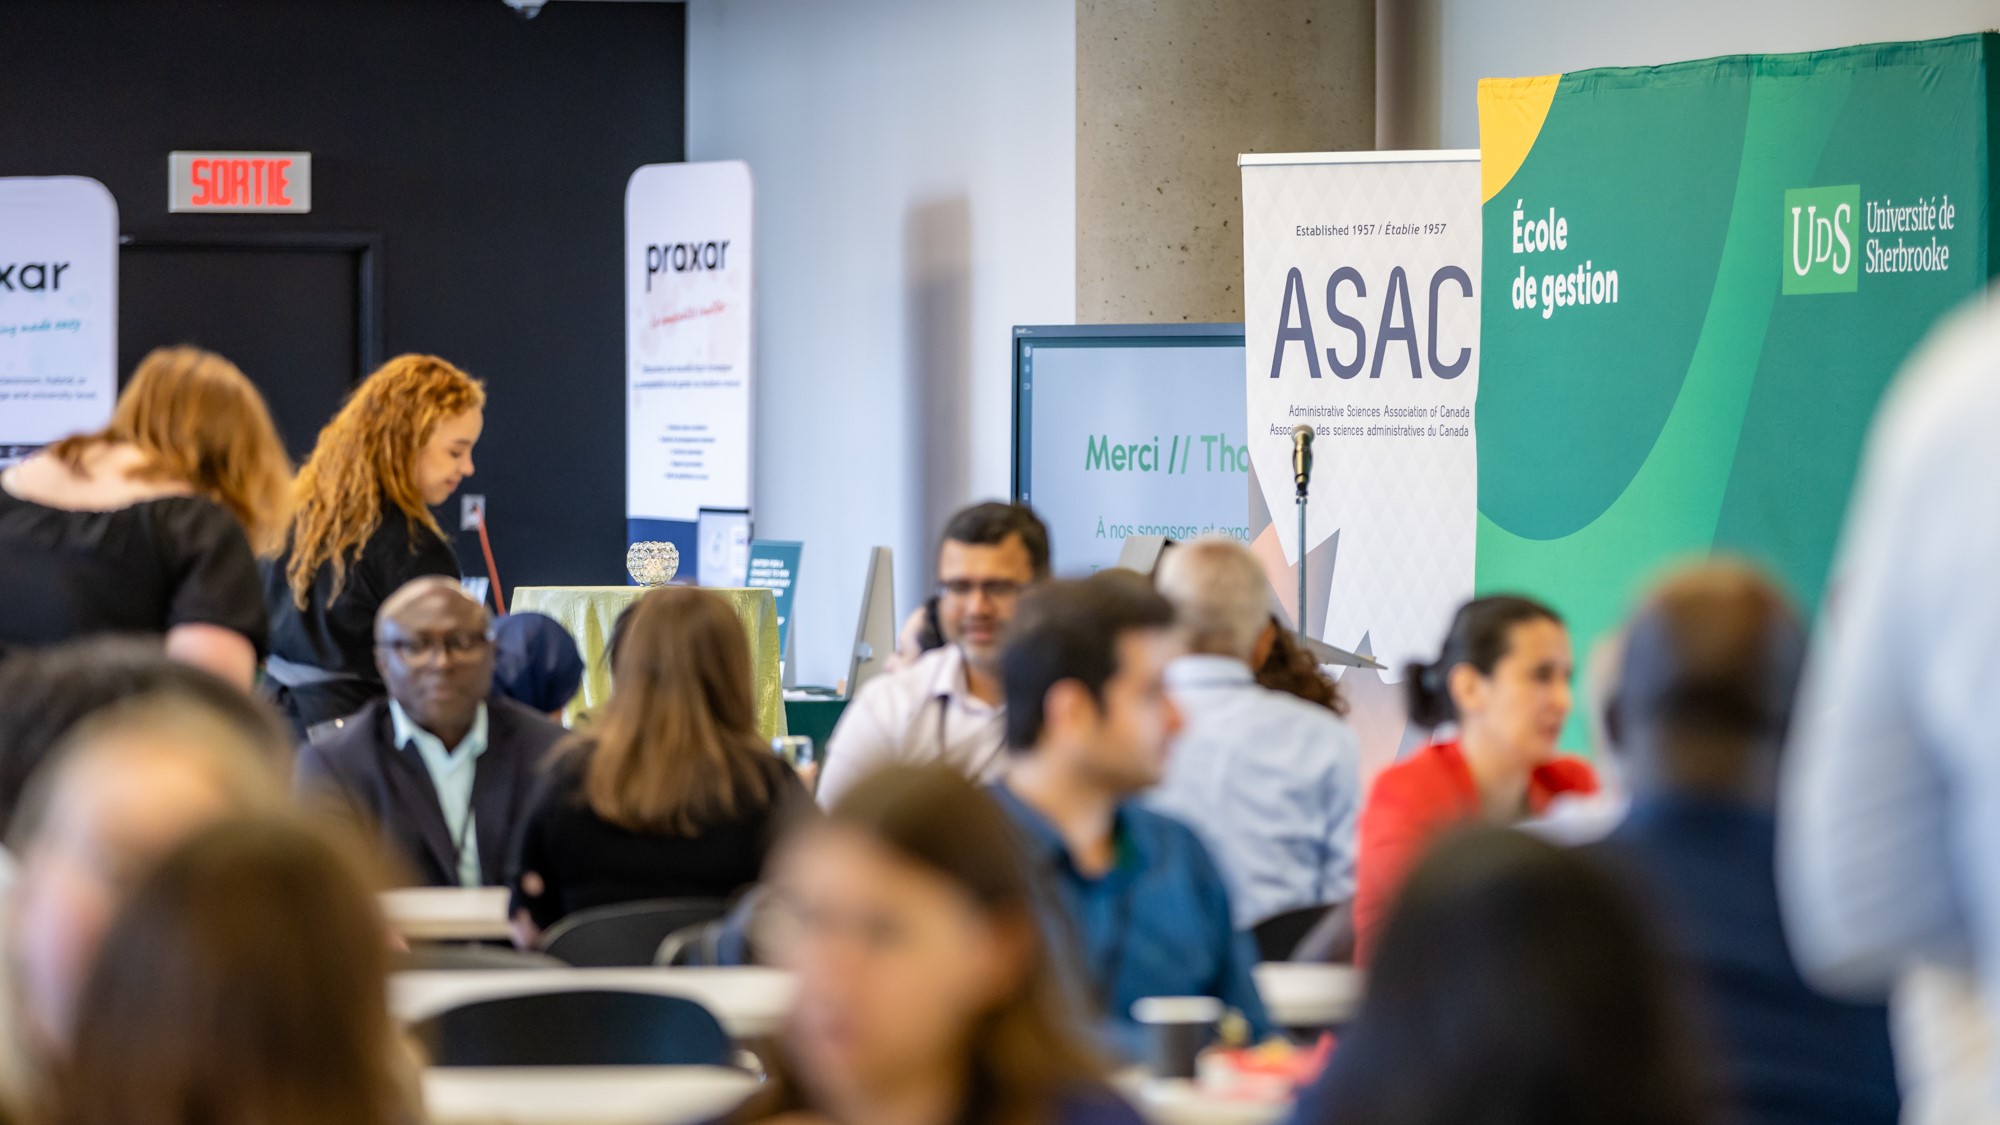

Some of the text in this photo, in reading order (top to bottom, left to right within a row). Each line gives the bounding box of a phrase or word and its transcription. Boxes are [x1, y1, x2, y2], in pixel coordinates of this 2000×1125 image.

[191, 159, 292, 206] SORTIE
[1296, 225, 1349, 236] Established
[1352, 225, 1375, 235] 1957
[1385, 221, 1420, 235] Établie
[1423, 223, 1447, 235] 1957
[1512, 199, 1568, 254] École
[1867, 194, 1955, 233] Université de
[646, 239, 730, 293] praxar
[1865, 236, 1949, 273] Sherbrooke
[1512, 261, 1619, 319] de gestion
[1270, 265, 1473, 379] ASAC
[1289, 404, 1470, 418] Administrative Sciences Association of Canada
[1316, 424, 1330, 436] des
[1333, 424, 1364, 437] sciences
[1367, 424, 1425, 437] administratives
[1427, 424, 1437, 437] du
[1439, 424, 1469, 437] Canada
[1085, 434, 1159, 472] Merci
[1168, 435, 1191, 474] //
[1096, 516, 1106, 539] À
[1110, 524, 1133, 539] nos
